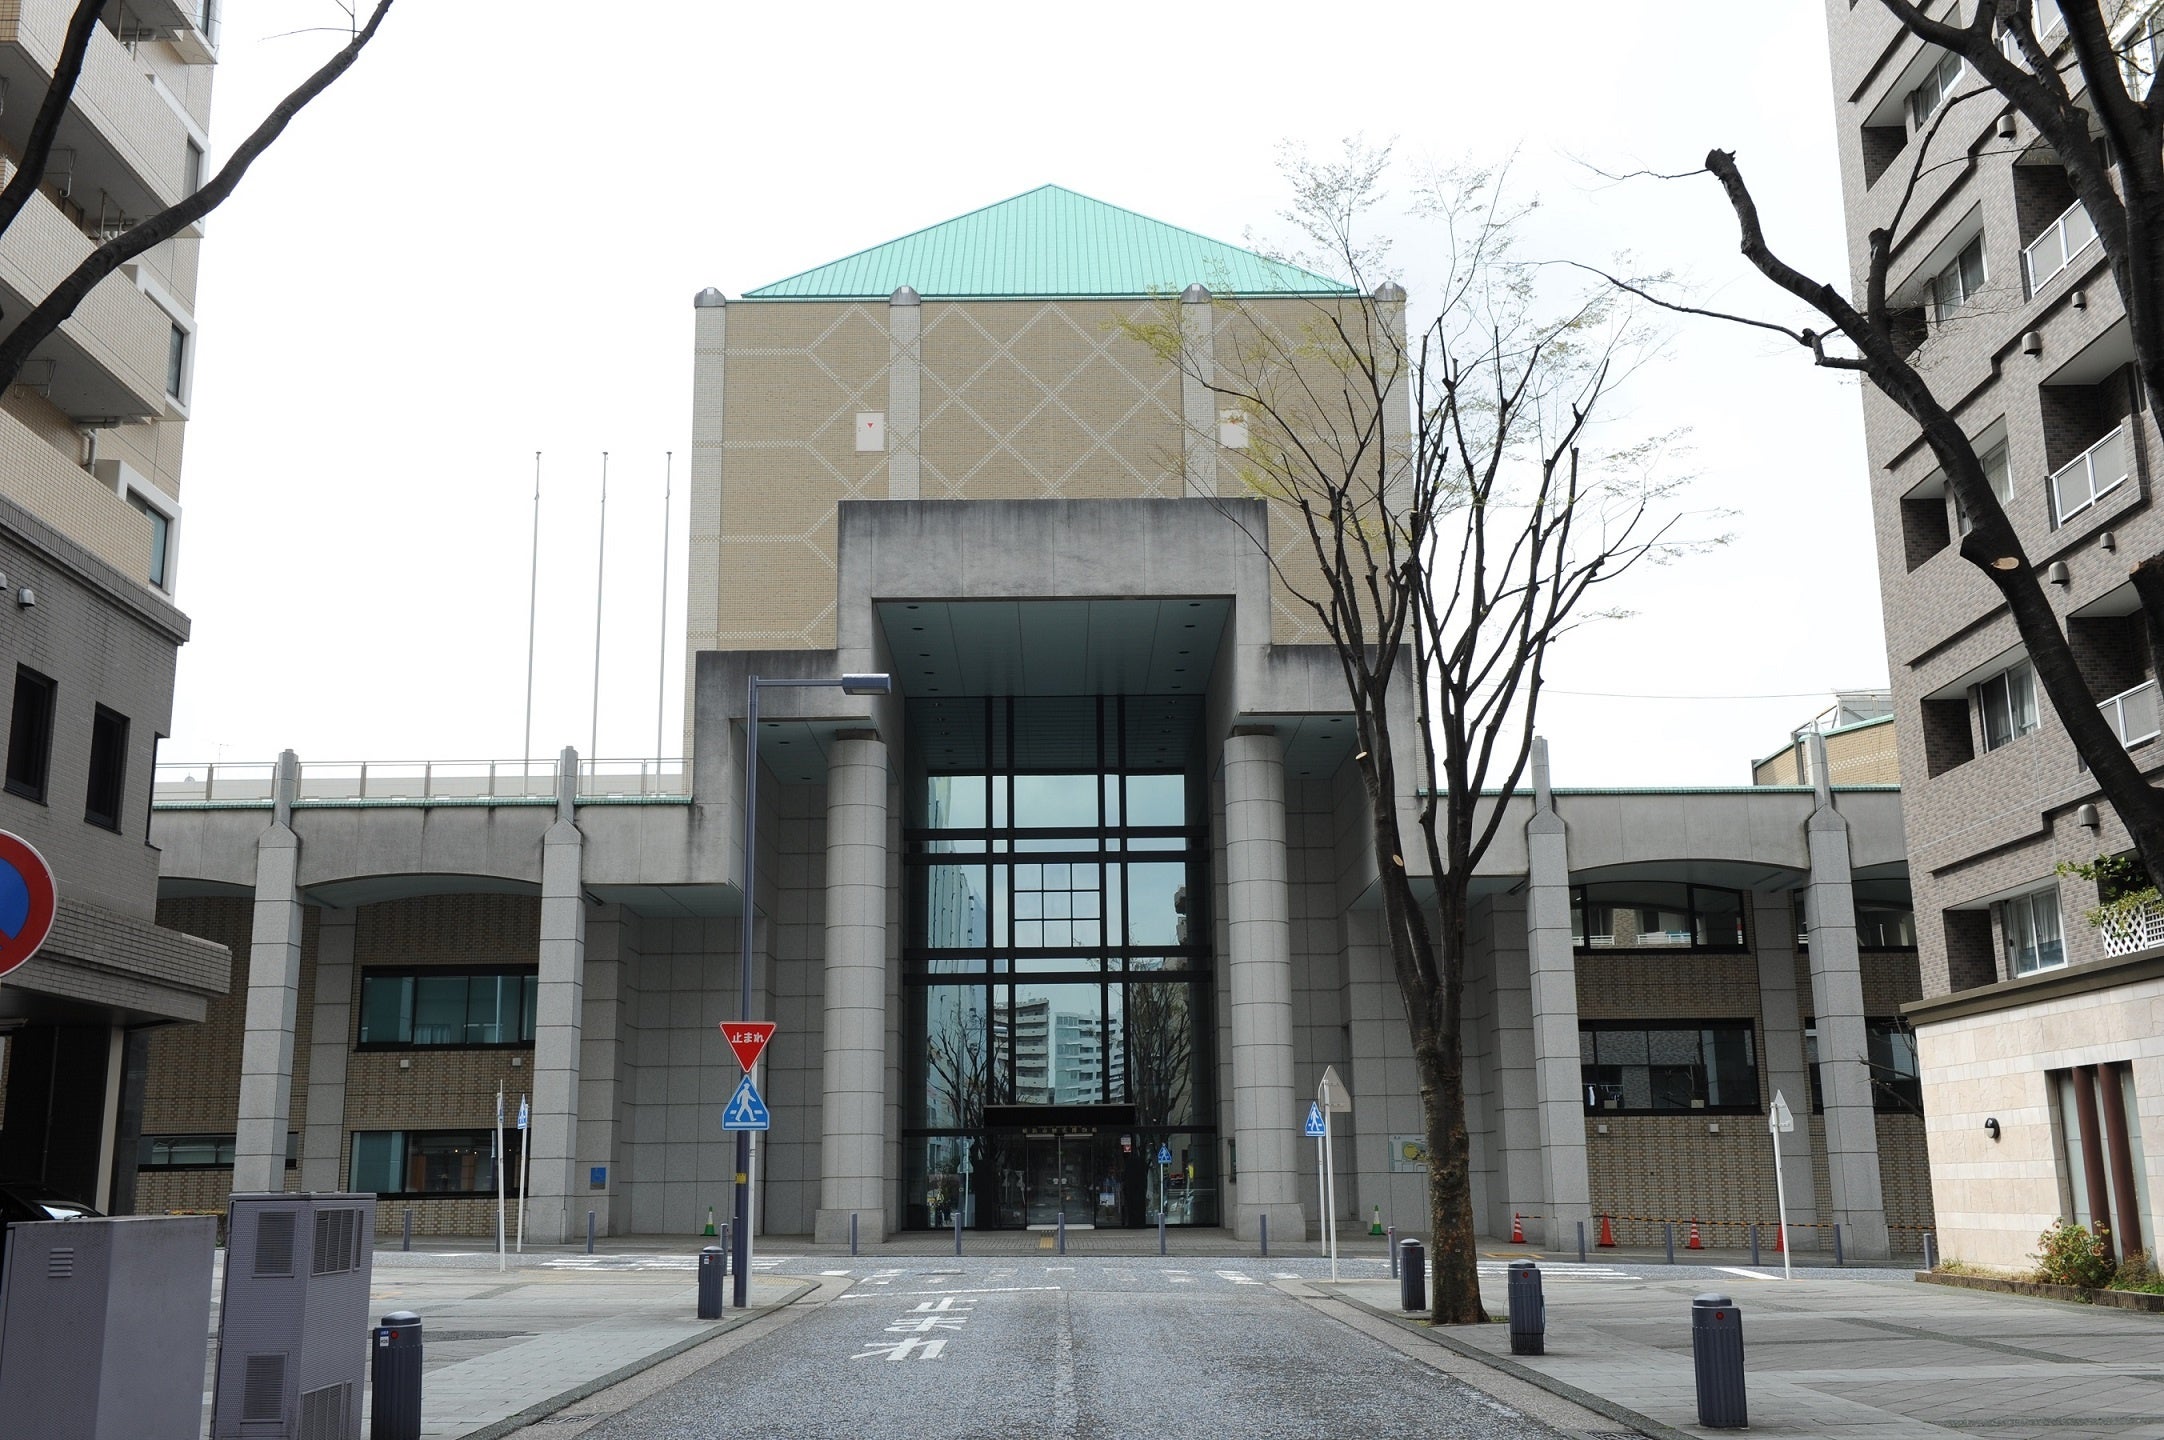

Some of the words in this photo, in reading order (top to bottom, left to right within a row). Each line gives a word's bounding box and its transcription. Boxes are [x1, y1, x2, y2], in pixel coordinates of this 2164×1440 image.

[731, 1031, 765, 1044] 止まれ
[850, 1296, 978, 1361] 止まれ
